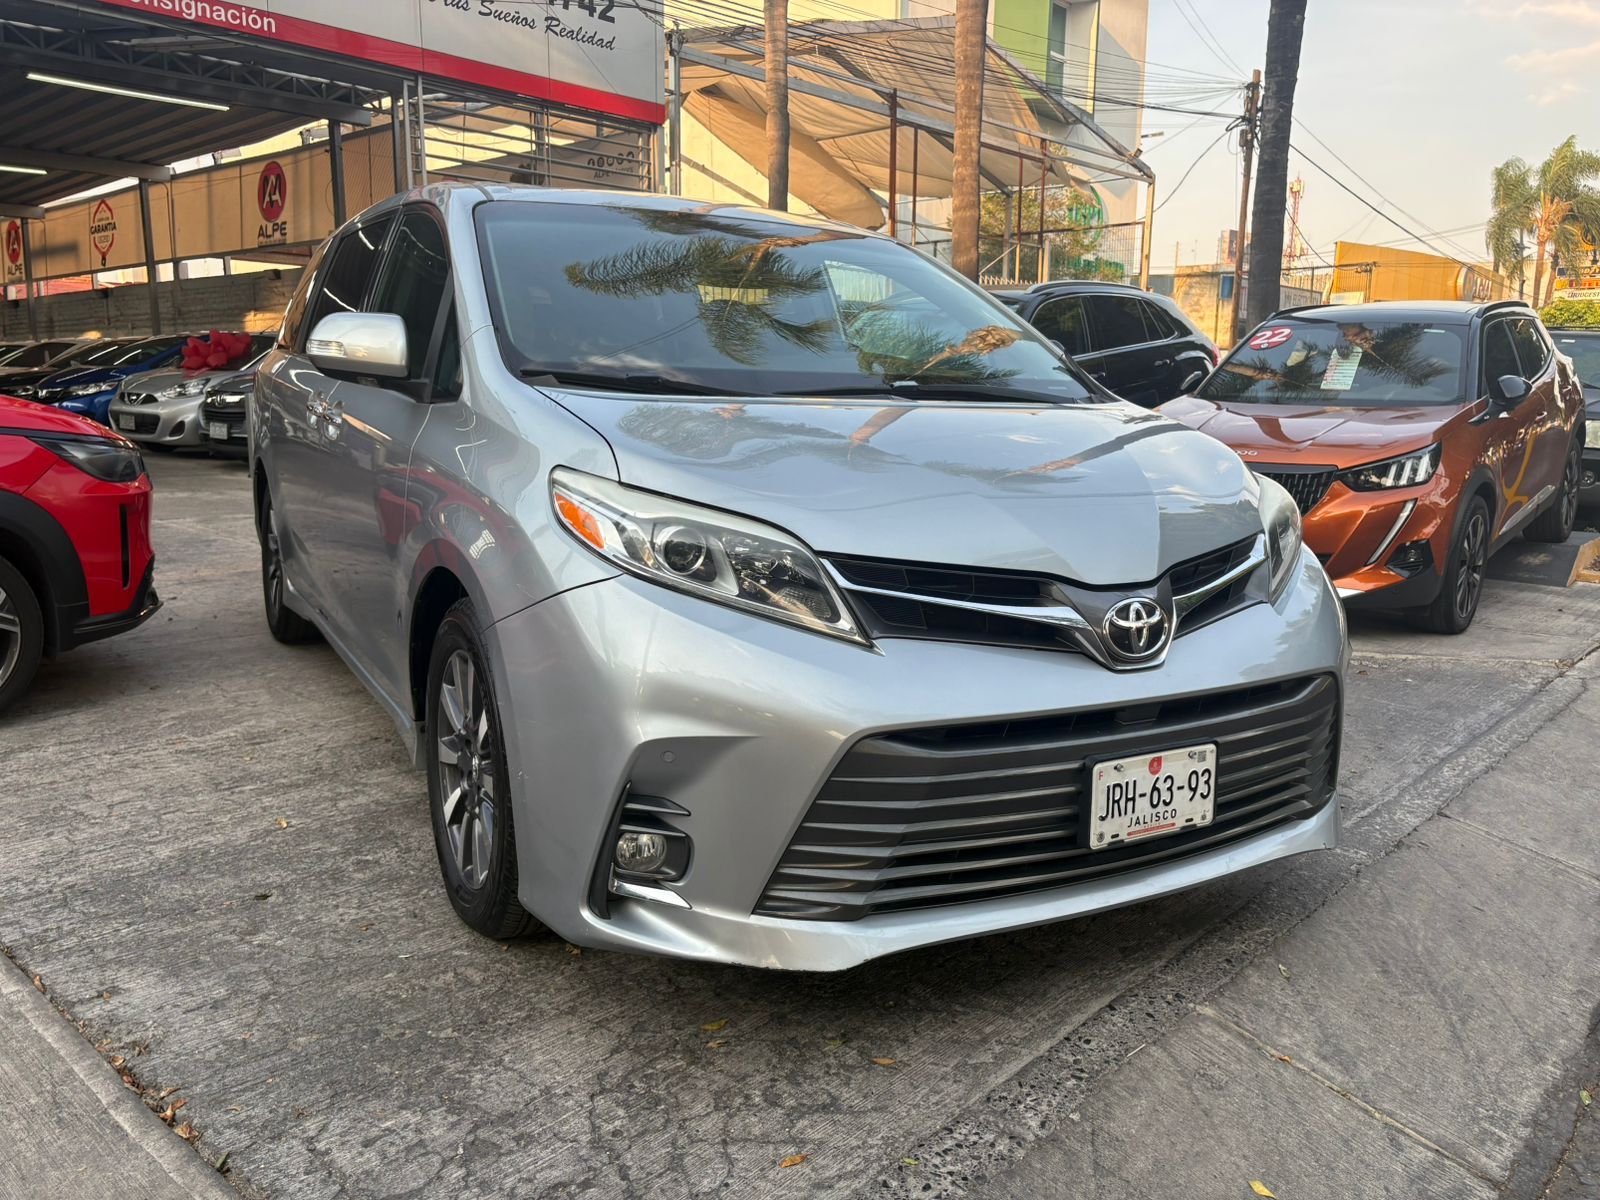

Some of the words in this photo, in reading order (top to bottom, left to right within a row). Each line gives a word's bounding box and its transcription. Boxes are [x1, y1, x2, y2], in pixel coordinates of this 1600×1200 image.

[131, 0, 276, 33] signación
[478, 0, 537, 29] Sueños
[544, 16, 616, 51] Realidad
[257, 221, 287, 239] ALPE
[7, 263, 23, 276] ALPE
[1249, 328, 1291, 346] 22
[1098, 770, 1104, 781] F
[1098, 767, 1212, 822] JRH-63-93
[1127, 808, 1178, 828] JALISCO
